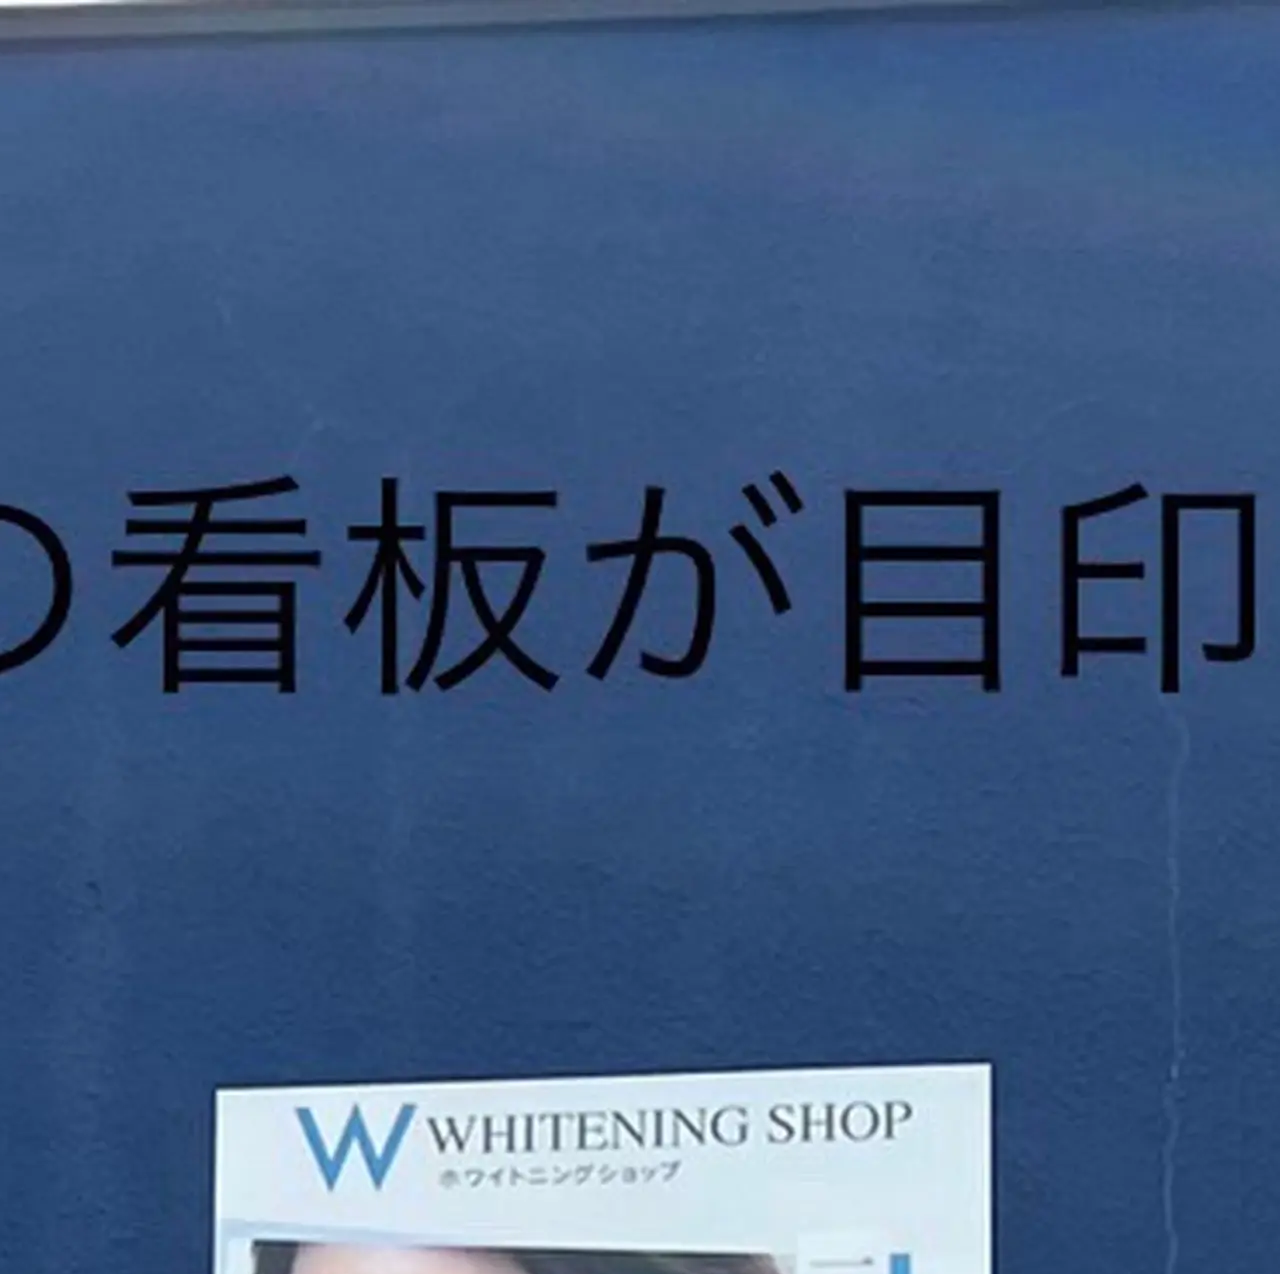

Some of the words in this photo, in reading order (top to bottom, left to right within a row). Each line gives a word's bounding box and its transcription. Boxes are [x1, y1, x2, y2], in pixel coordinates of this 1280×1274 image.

[426, 1107, 749, 1154] WHITENING
[767, 1101, 914, 1144] SHOP
[439, 1160, 682, 1189] ホワイトニングショップ
